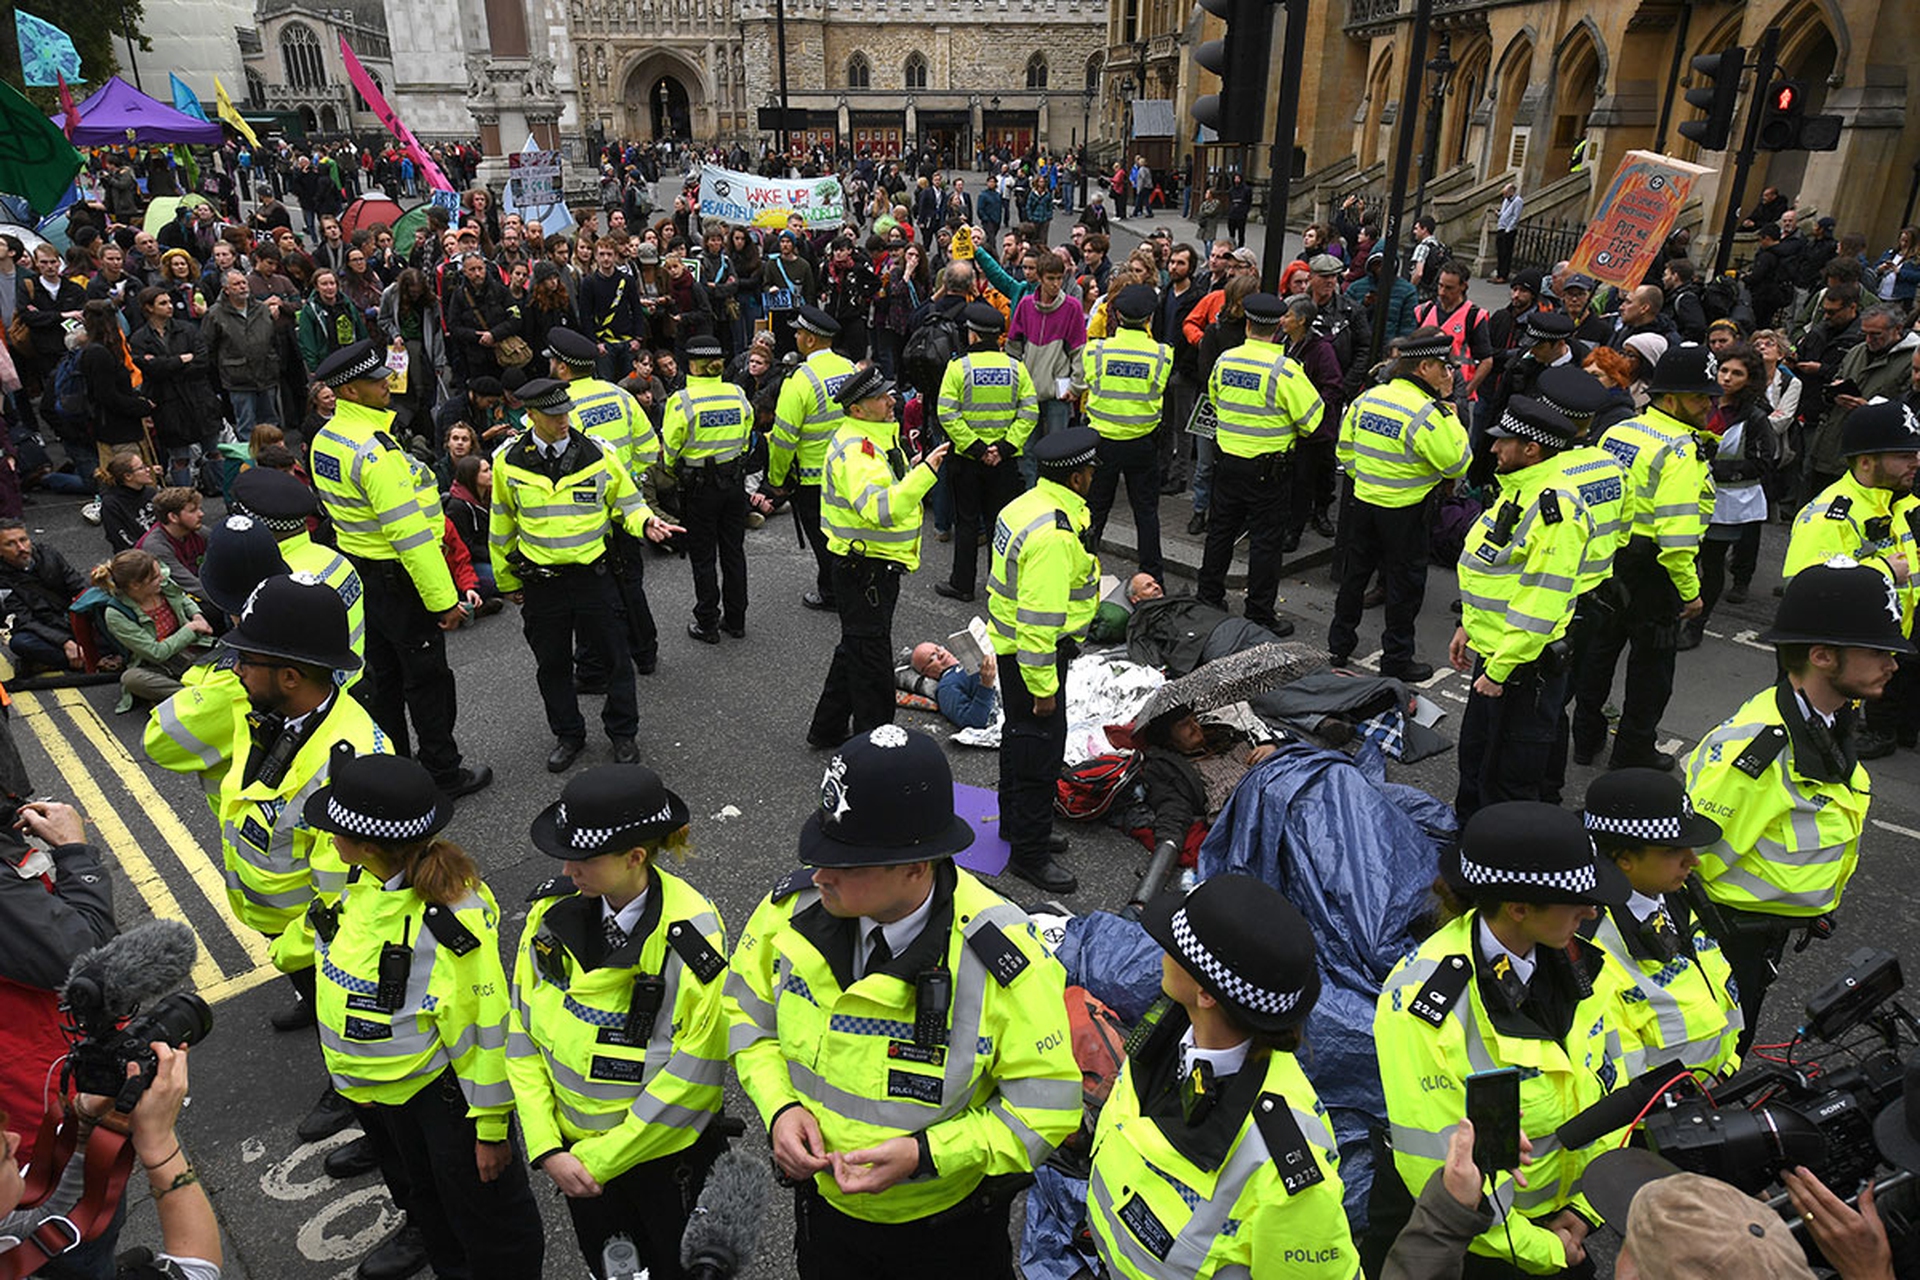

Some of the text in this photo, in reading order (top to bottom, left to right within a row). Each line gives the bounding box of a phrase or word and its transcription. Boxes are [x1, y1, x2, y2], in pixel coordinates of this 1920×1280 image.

[746, 186, 810, 204] WAKE UP!
[1613, 219, 1636, 237] PUT
[1608, 236, 1641, 258] FIRE
[975, 373, 1009, 385] POLICE
[1107, 364, 1149, 378] POLICE
[1222, 374, 1260, 390] POLICE
[582, 404, 622, 426] POLICE
[701, 413, 741, 426] POLICE
[1359, 418, 1401, 440] POLICE
[1584, 484, 1621, 505] OLICE
[1697, 797, 1736, 819] POLICE
[998, 951, 1013, 966] CN
[1430, 991, 1448, 1006] CN
[1036, 1030, 1064, 1055] POLI
[1420, 1075, 1458, 1092] OLICE
[1820, 1100, 1846, 1116] SONY
[1285, 1150, 1303, 1165] CN
[1285, 1166, 1319, 1189] 2275
[1284, 1247, 1340, 1263] POLICE
